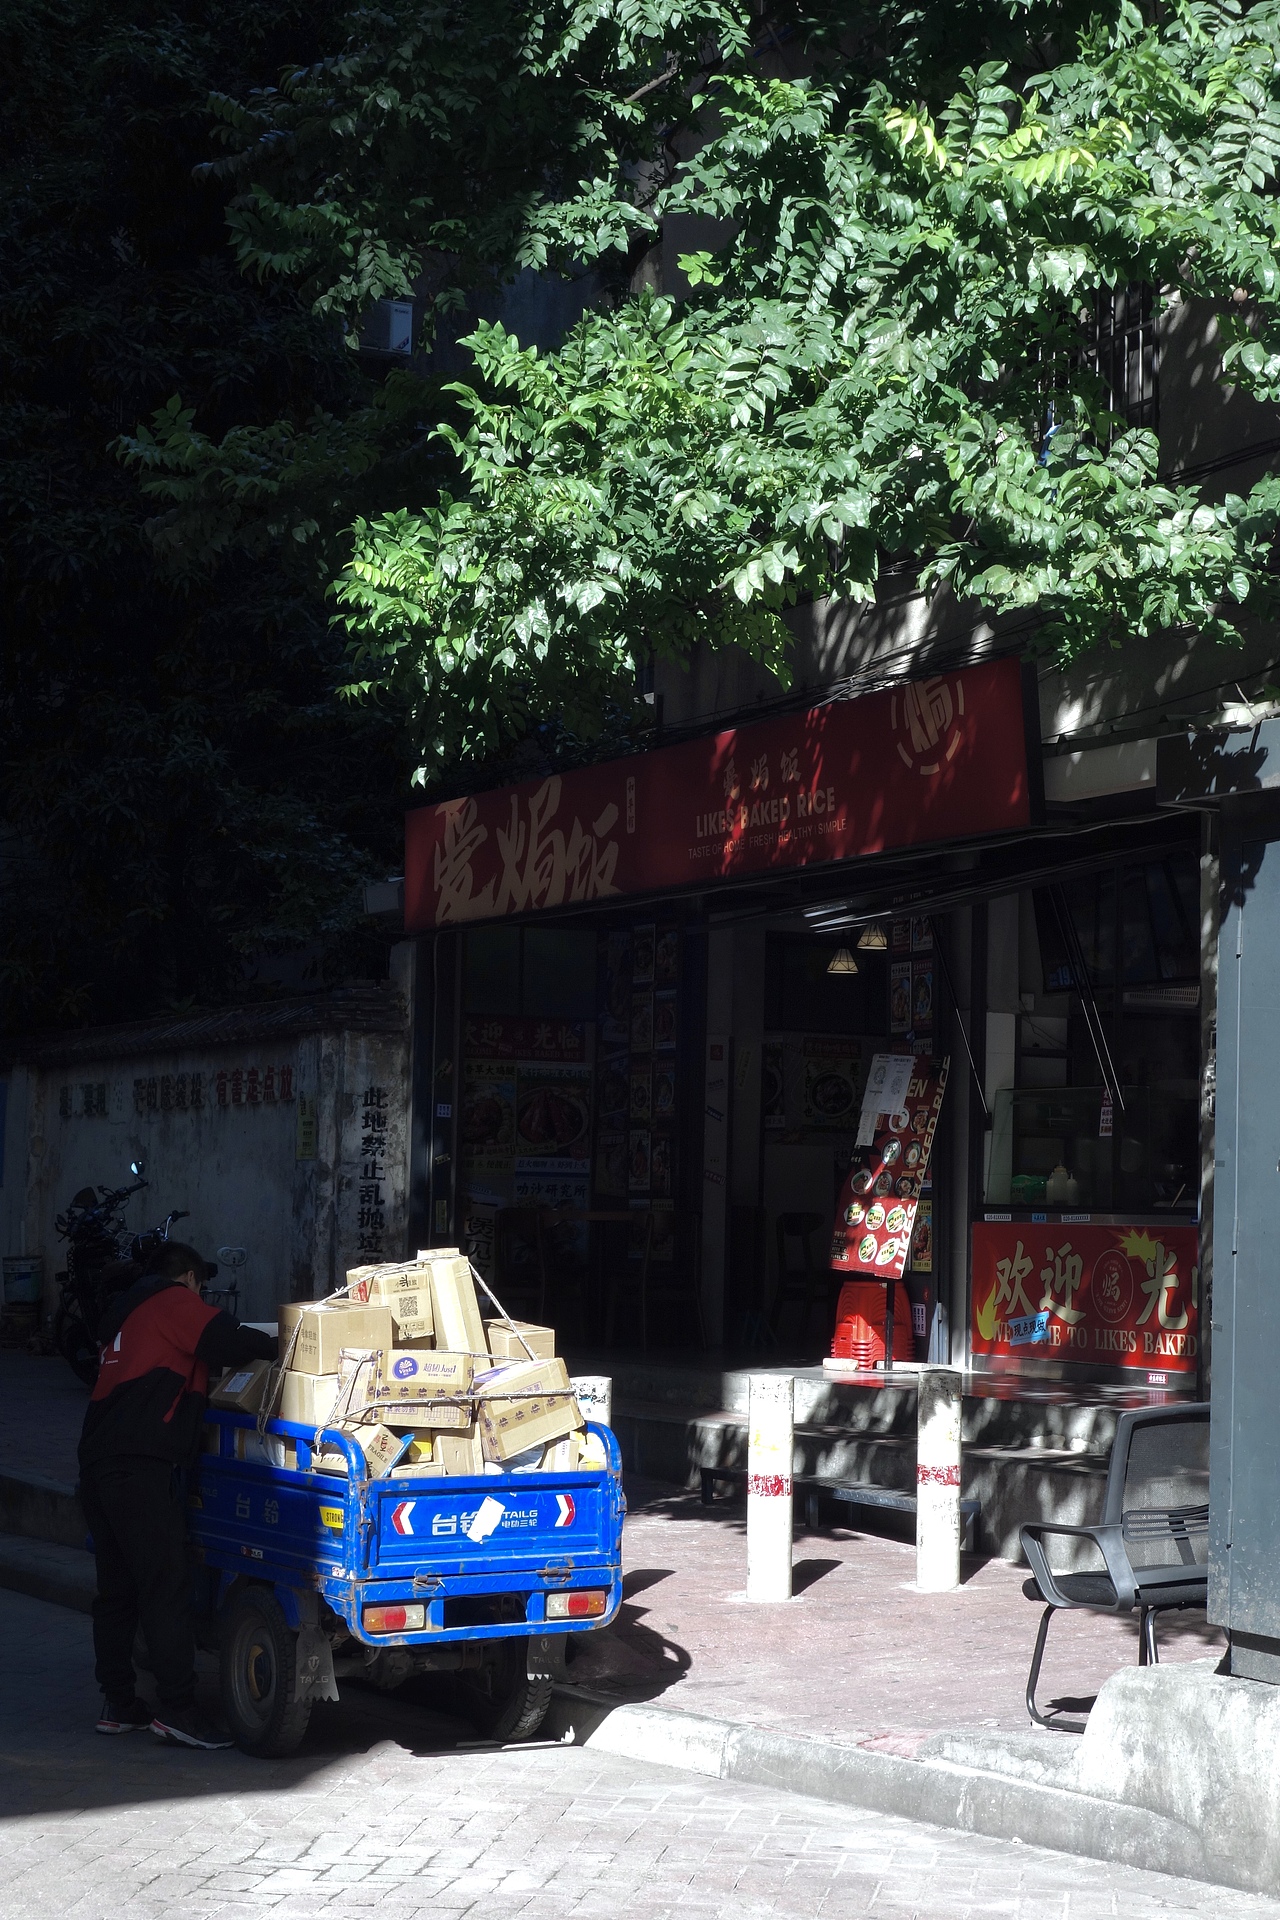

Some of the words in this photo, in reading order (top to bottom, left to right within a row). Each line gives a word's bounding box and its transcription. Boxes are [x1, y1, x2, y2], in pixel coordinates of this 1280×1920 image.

[697, 808, 735, 838] LIKES
[741, 798, 791, 829] BAKED
[797, 786, 836, 818] RICE
[688, 845, 711, 860] TASTE
[712, 843, 723, 857] OF
[723, 838, 746, 854] HOME
[750, 832, 774, 849] FRESH
[778, 824, 813, 845] HEALTHY
[818, 818, 848, 835] SIMPLE
[532, 1023, 581, 1050] 光临
[993, 1240, 1087, 1325] 欢迎
[1135, 1241, 1198, 1331] 光
[991, 1320, 1061, 1347] WEME
[1067, 1327, 1087, 1348] TO
[1094, 1329, 1137, 1353] LIKES
[1143, 1332, 1198, 1358] BAKED
[1013, 1318, 1048, 1339] 现点现做
[367, 1444, 388, 1465] FRAGILE
[236, 1493, 280, 1525] 台铃
[502, 1509, 538, 1520] TAILG
[501, 1519, 538, 1529] 电动三轮
[532, 1656, 560, 1665] TAILG
[300, 1675, 329, 1684] TAILG
